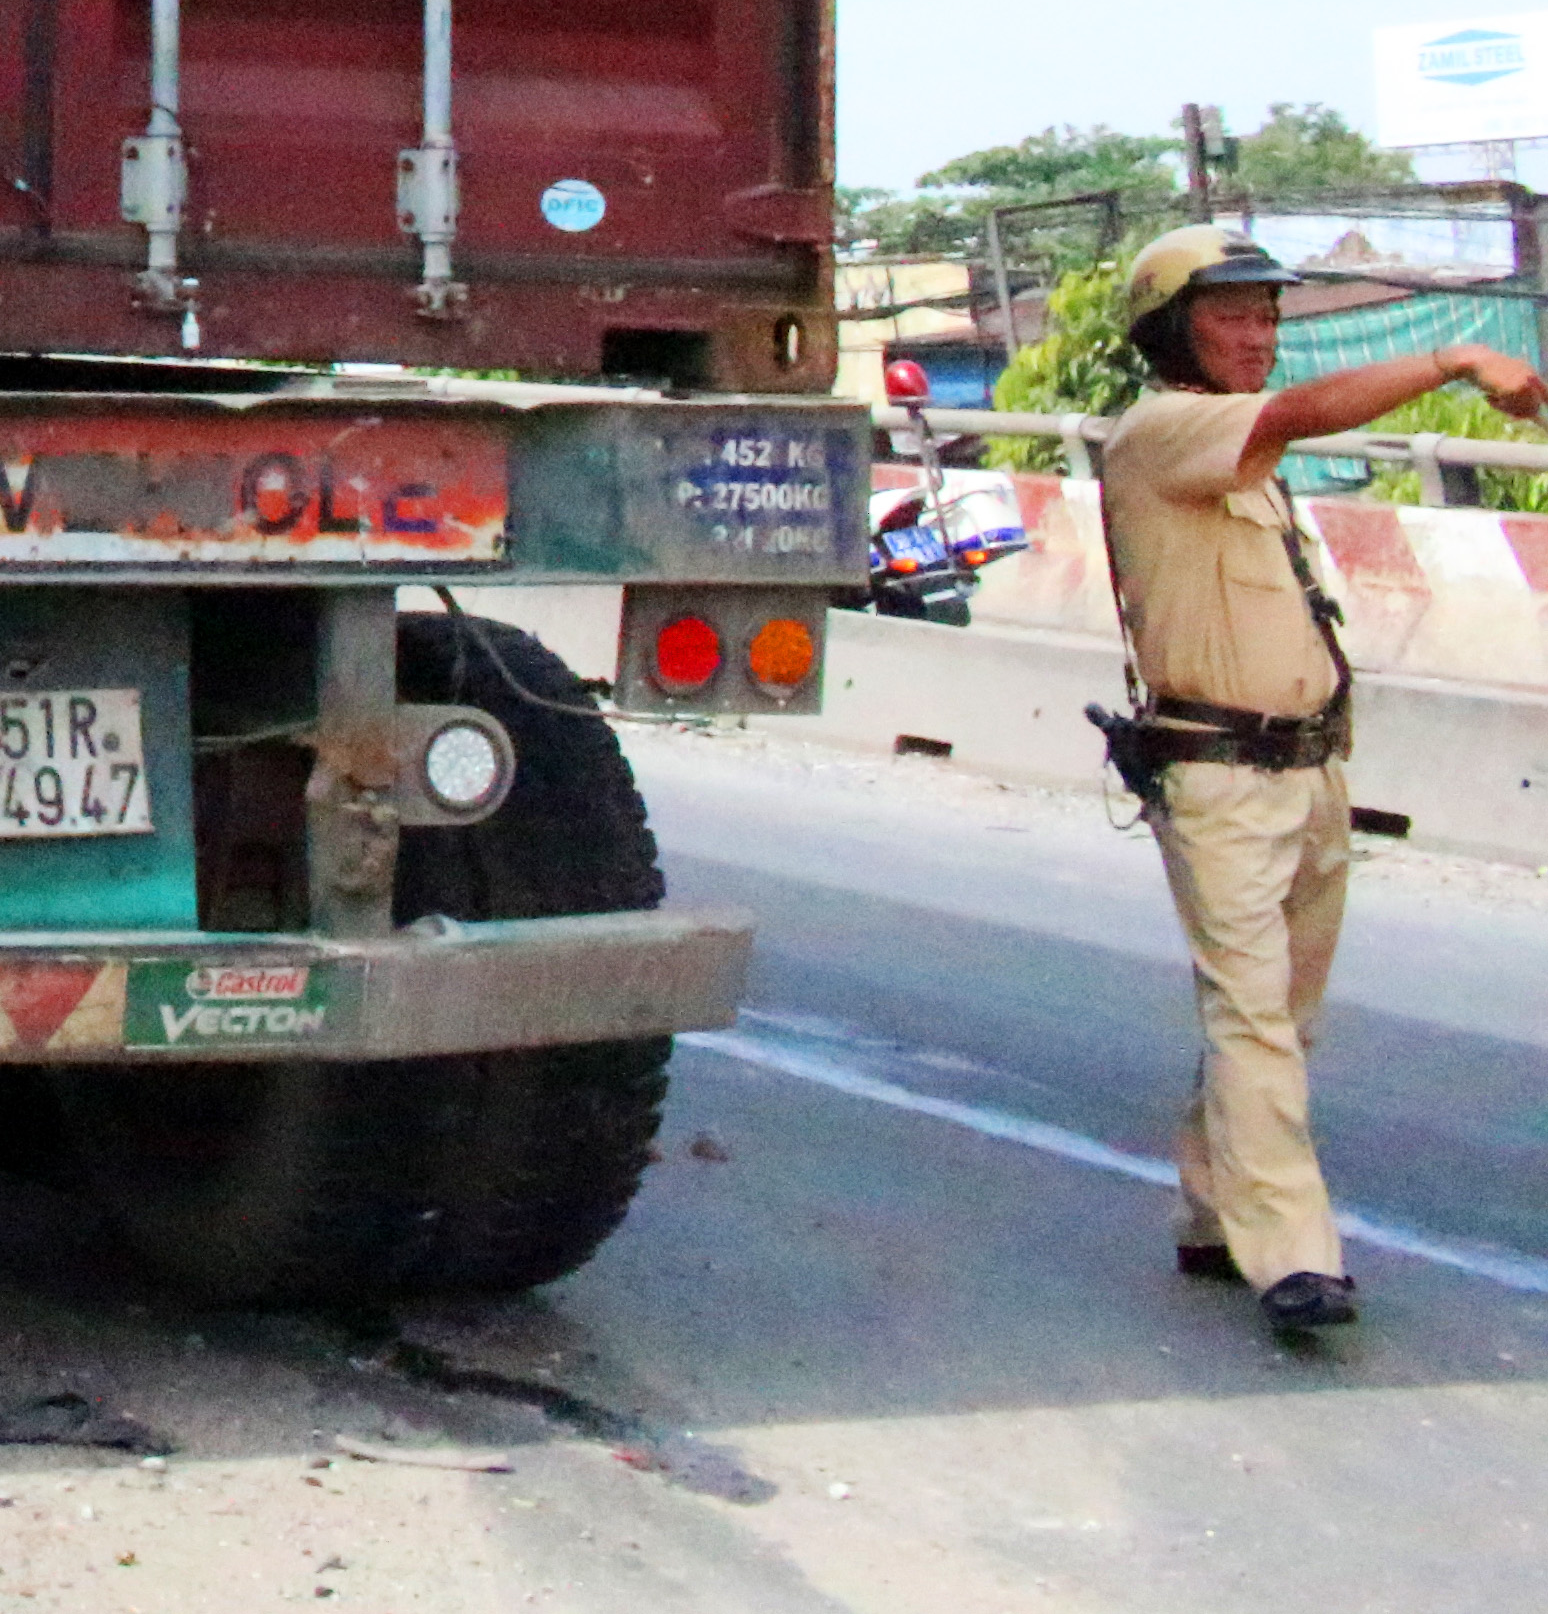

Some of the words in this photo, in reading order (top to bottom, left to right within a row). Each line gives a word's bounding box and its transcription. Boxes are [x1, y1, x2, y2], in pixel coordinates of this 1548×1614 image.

[1418, 50, 1470, 72] ZAMIL
[1474, 43, 1525, 66] STEEL
[215, 970, 302, 995] Castrol
[159, 1003, 326, 1043] VECTON
